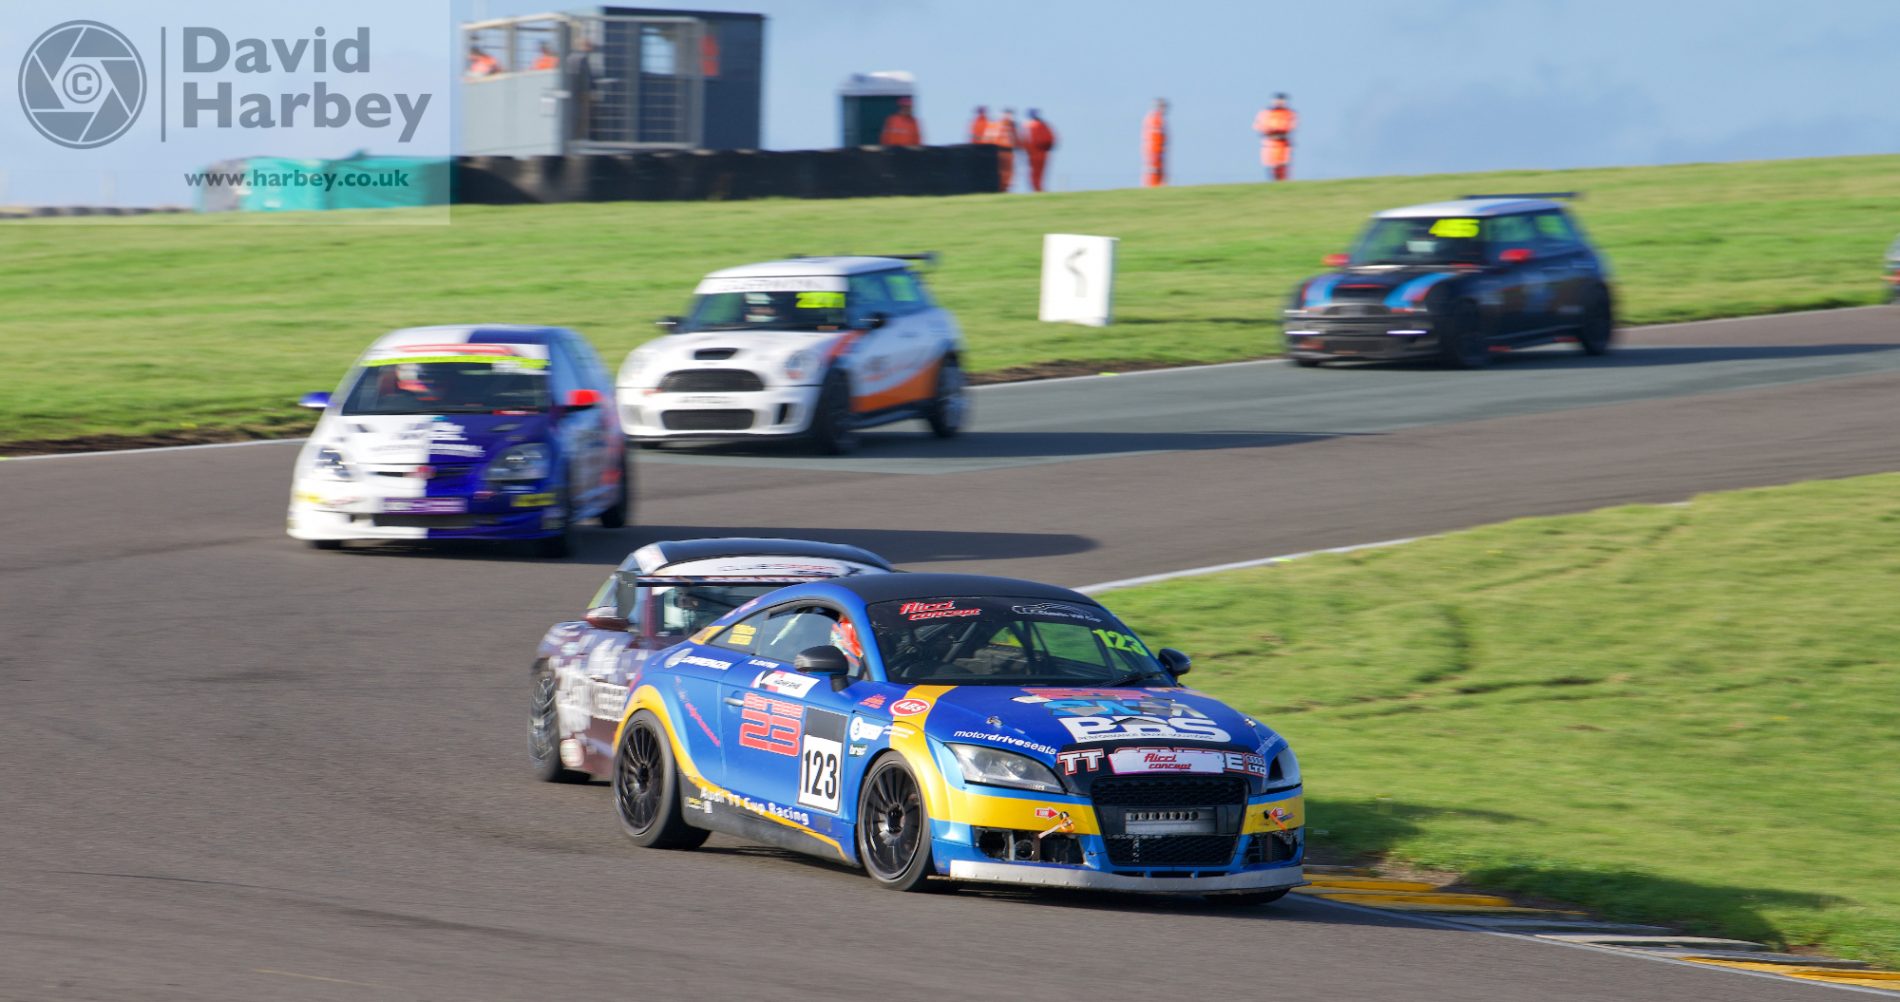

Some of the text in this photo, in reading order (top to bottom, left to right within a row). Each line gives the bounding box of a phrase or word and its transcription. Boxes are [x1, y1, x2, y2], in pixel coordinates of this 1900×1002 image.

[1092, 628, 1149, 657] 123
[896, 701, 927, 713] ABS
[739, 708, 802, 757] 23
[953, 729, 1058, 756] motordriveseats
[803, 749, 838, 800] 123
[1058, 749, 1104, 775] TT
[1247, 763, 1266, 776] LTD
[744, 798, 765, 815] Cup
[768, 802, 810, 825] Racing
